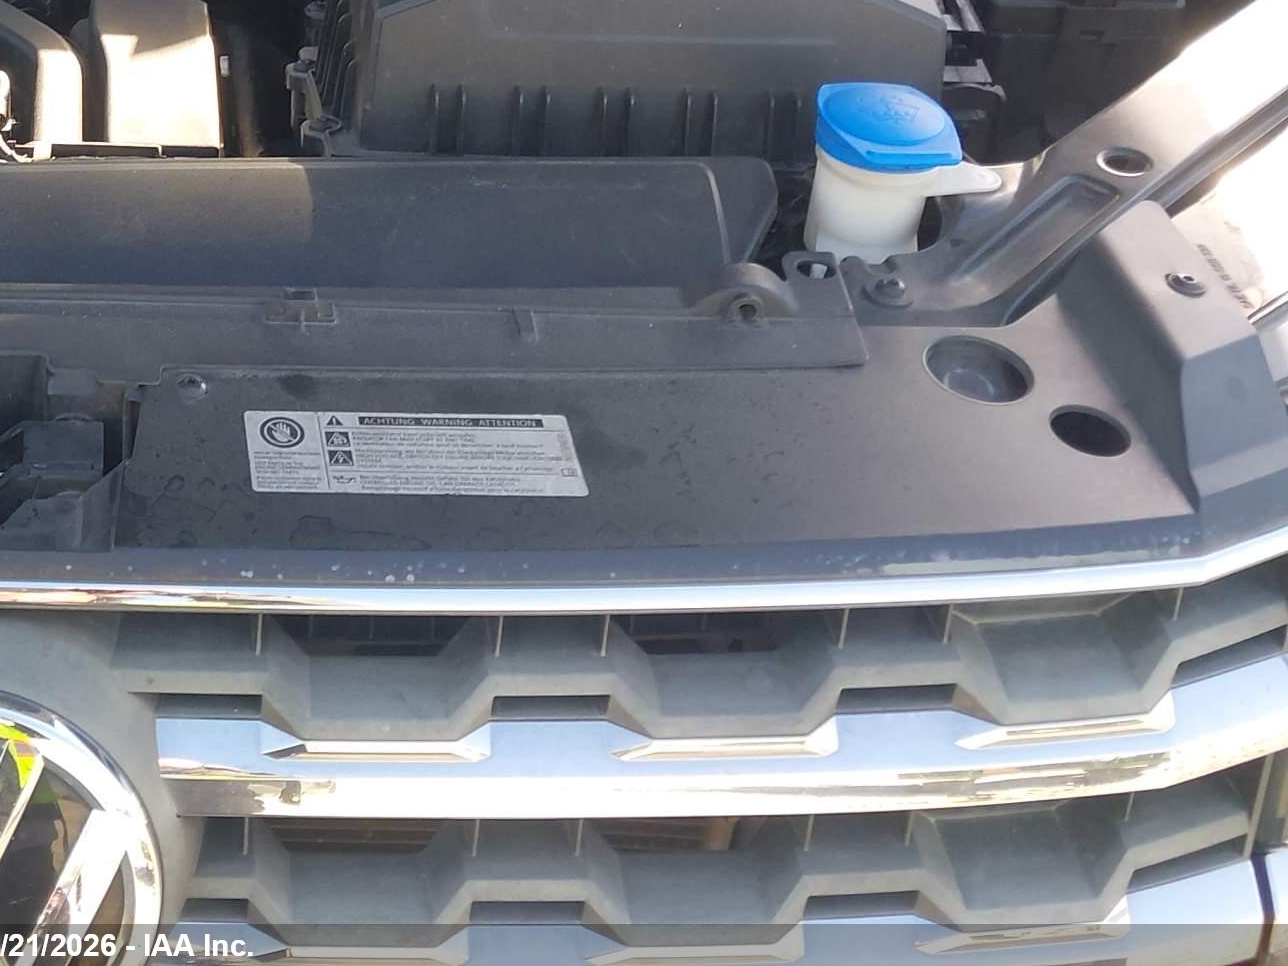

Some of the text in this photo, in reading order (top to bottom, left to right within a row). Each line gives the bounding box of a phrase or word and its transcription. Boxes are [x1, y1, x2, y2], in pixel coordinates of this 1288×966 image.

[363, 418, 536, 427] ACHTUNG WARNING ATTENTION
